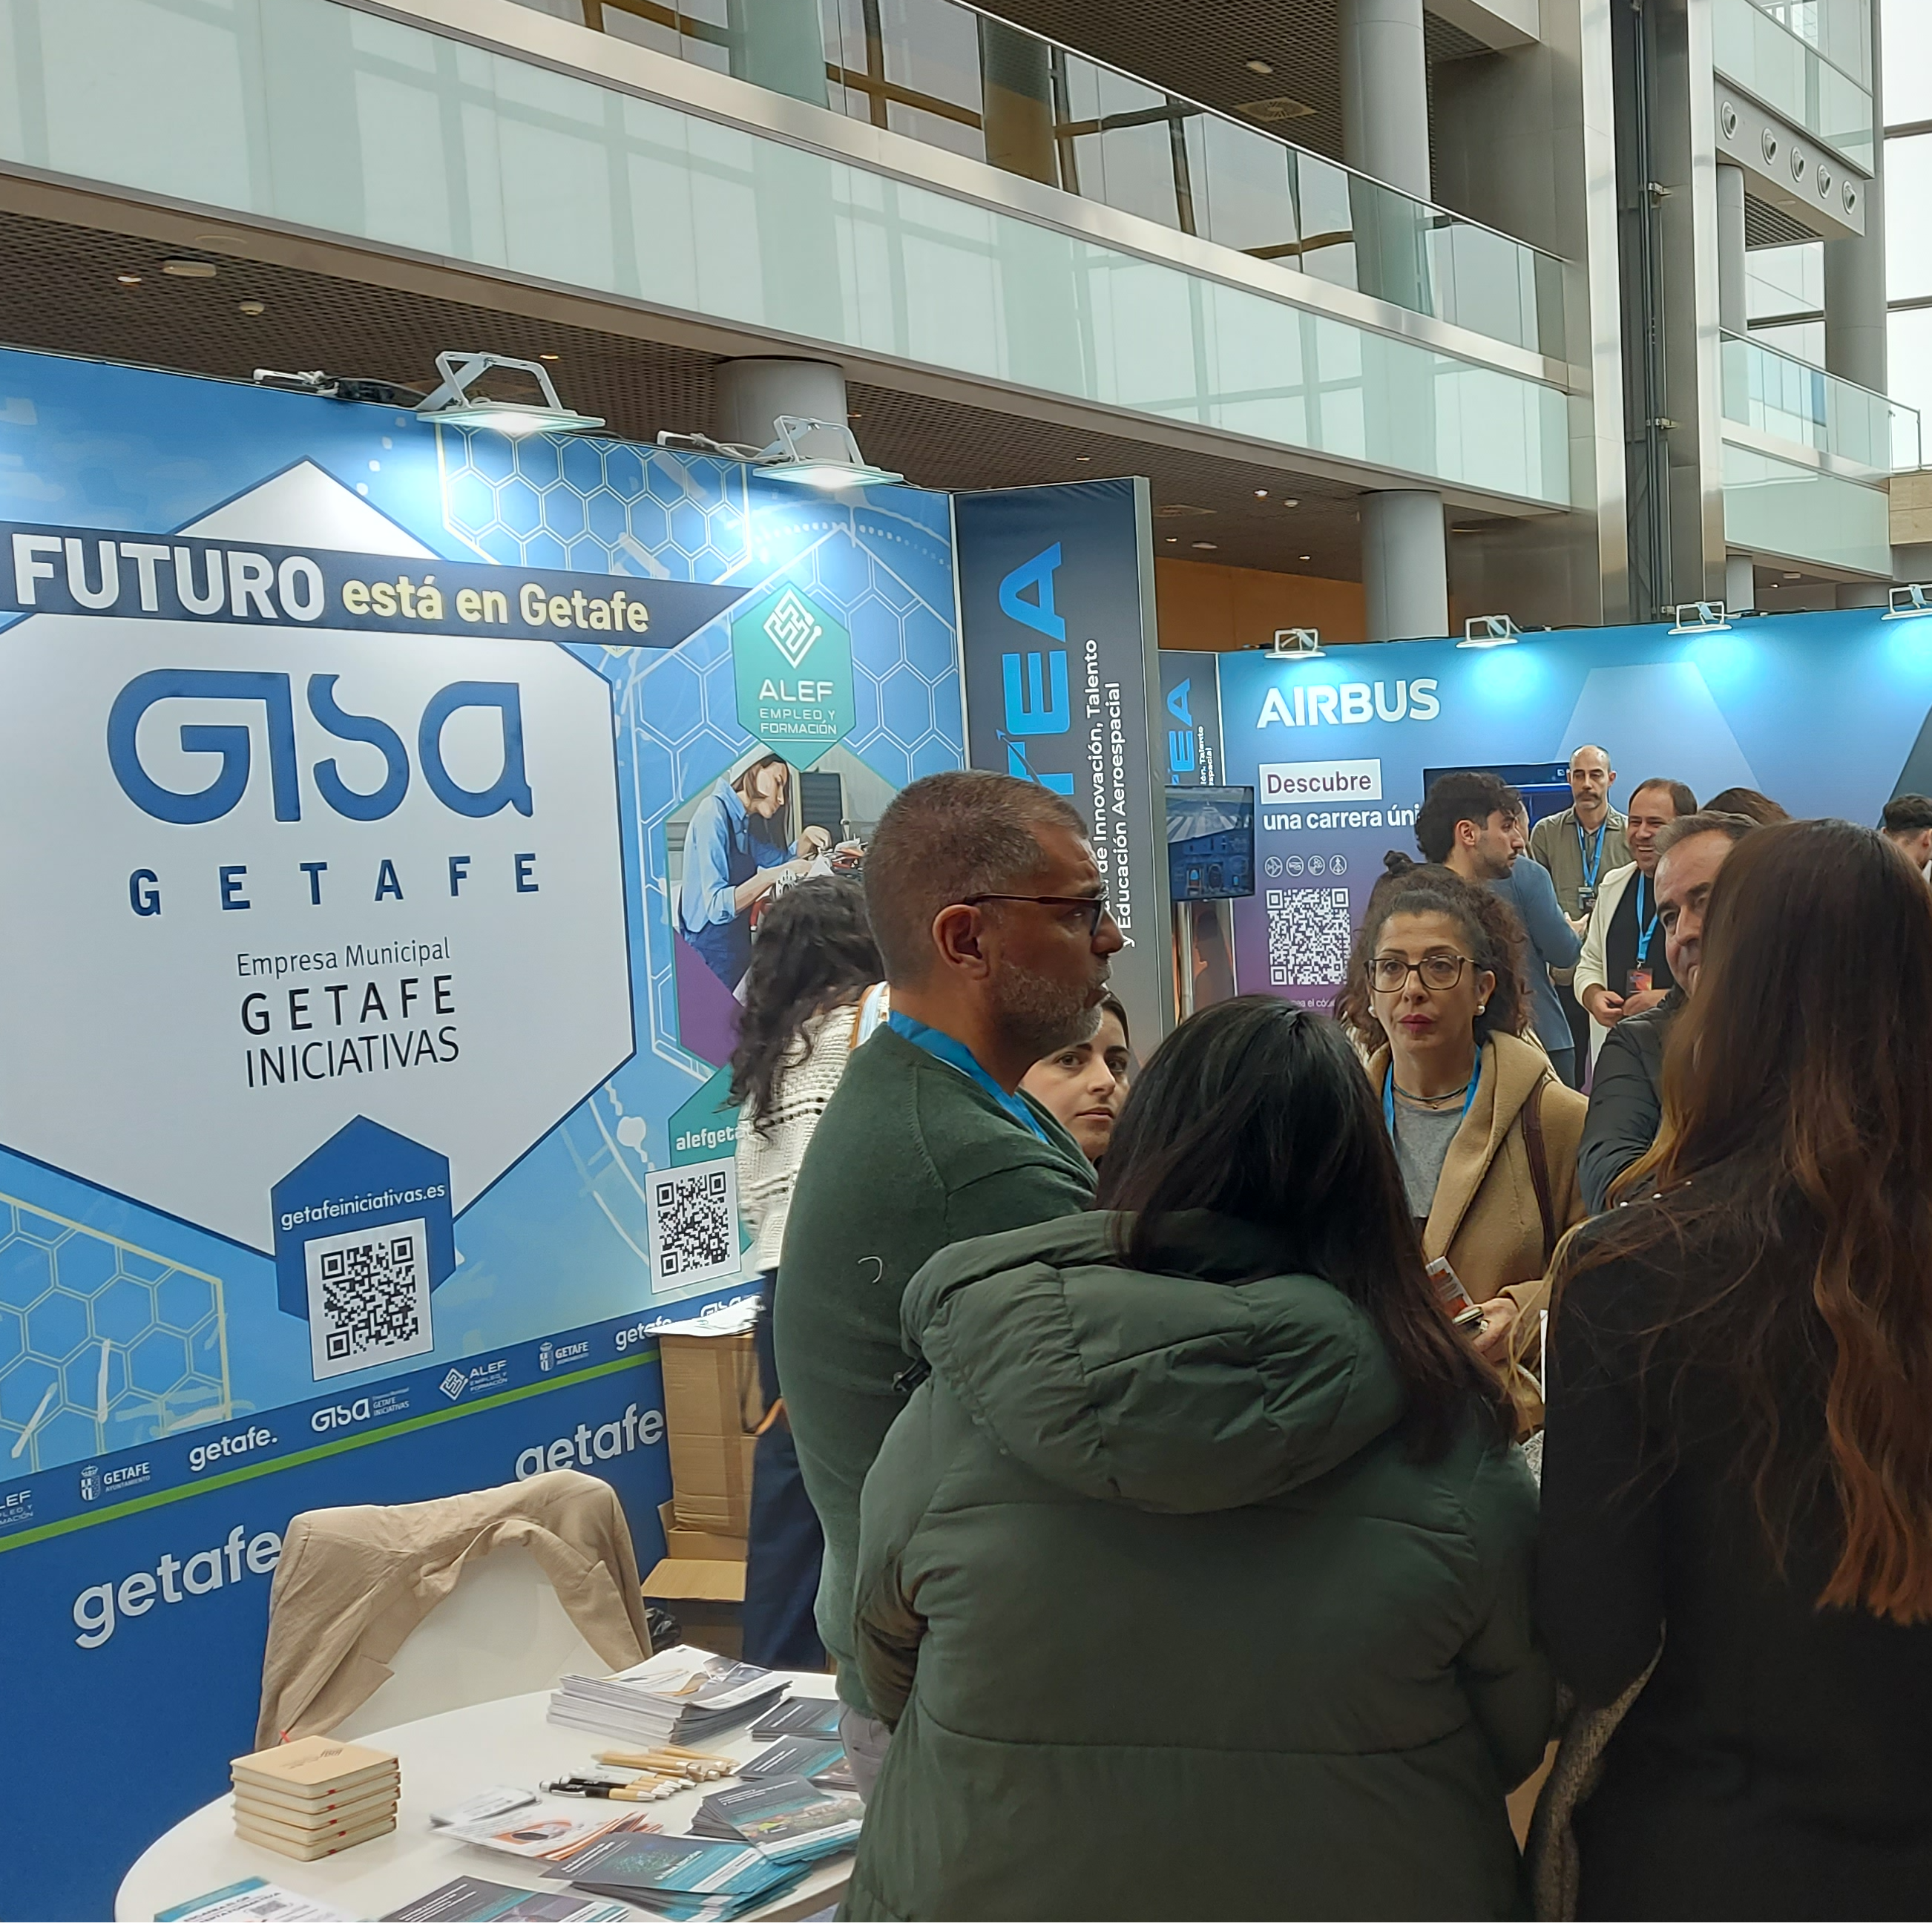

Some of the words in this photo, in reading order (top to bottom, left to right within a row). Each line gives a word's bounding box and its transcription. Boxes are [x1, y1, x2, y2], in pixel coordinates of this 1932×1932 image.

[11, 533, 325, 622] FUTURO
[342, 575, 443, 620] está
[456, 588, 508, 624] en
[519, 582, 649, 633] Getafe
[759, 679, 833, 702] ALEF
[1084, 640, 1101, 718] Talento
[759, 709, 822, 720] EMPLEO
[828, 710, 835, 720] Y
[1256, 678, 1440, 729] AIRBUS
[760, 720, 837, 735] FORMACIÓN
[1105, 683, 1126, 816] Aeroespacial
[1197, 726, 1206, 765] Talento
[1087, 723, 1107, 841] Innovación,
[1267, 771, 1372, 795] Descubre
[1264, 813, 1301, 831] una
[1306, 810, 1382, 829] carrera
[128, 852, 539, 917] GETAFE
[1113, 821, 1131, 929] Educación
[237, 950, 338, 979] Empresa
[345, 936, 450, 967] Municipal
[240, 974, 456, 1036] GETAFE
[246, 1025, 460, 1088] INICIATIVAS
[280, 1184, 446, 1232] getafeiniciativas.es
[469, 1359, 507, 1379] ALEF
[555, 1341, 589, 1359] GETAFE
[189, 1426, 278, 1472] getafe.
[104, 1462, 151, 1485] GETAFE
[73, 1525, 283, 1649] getafe
